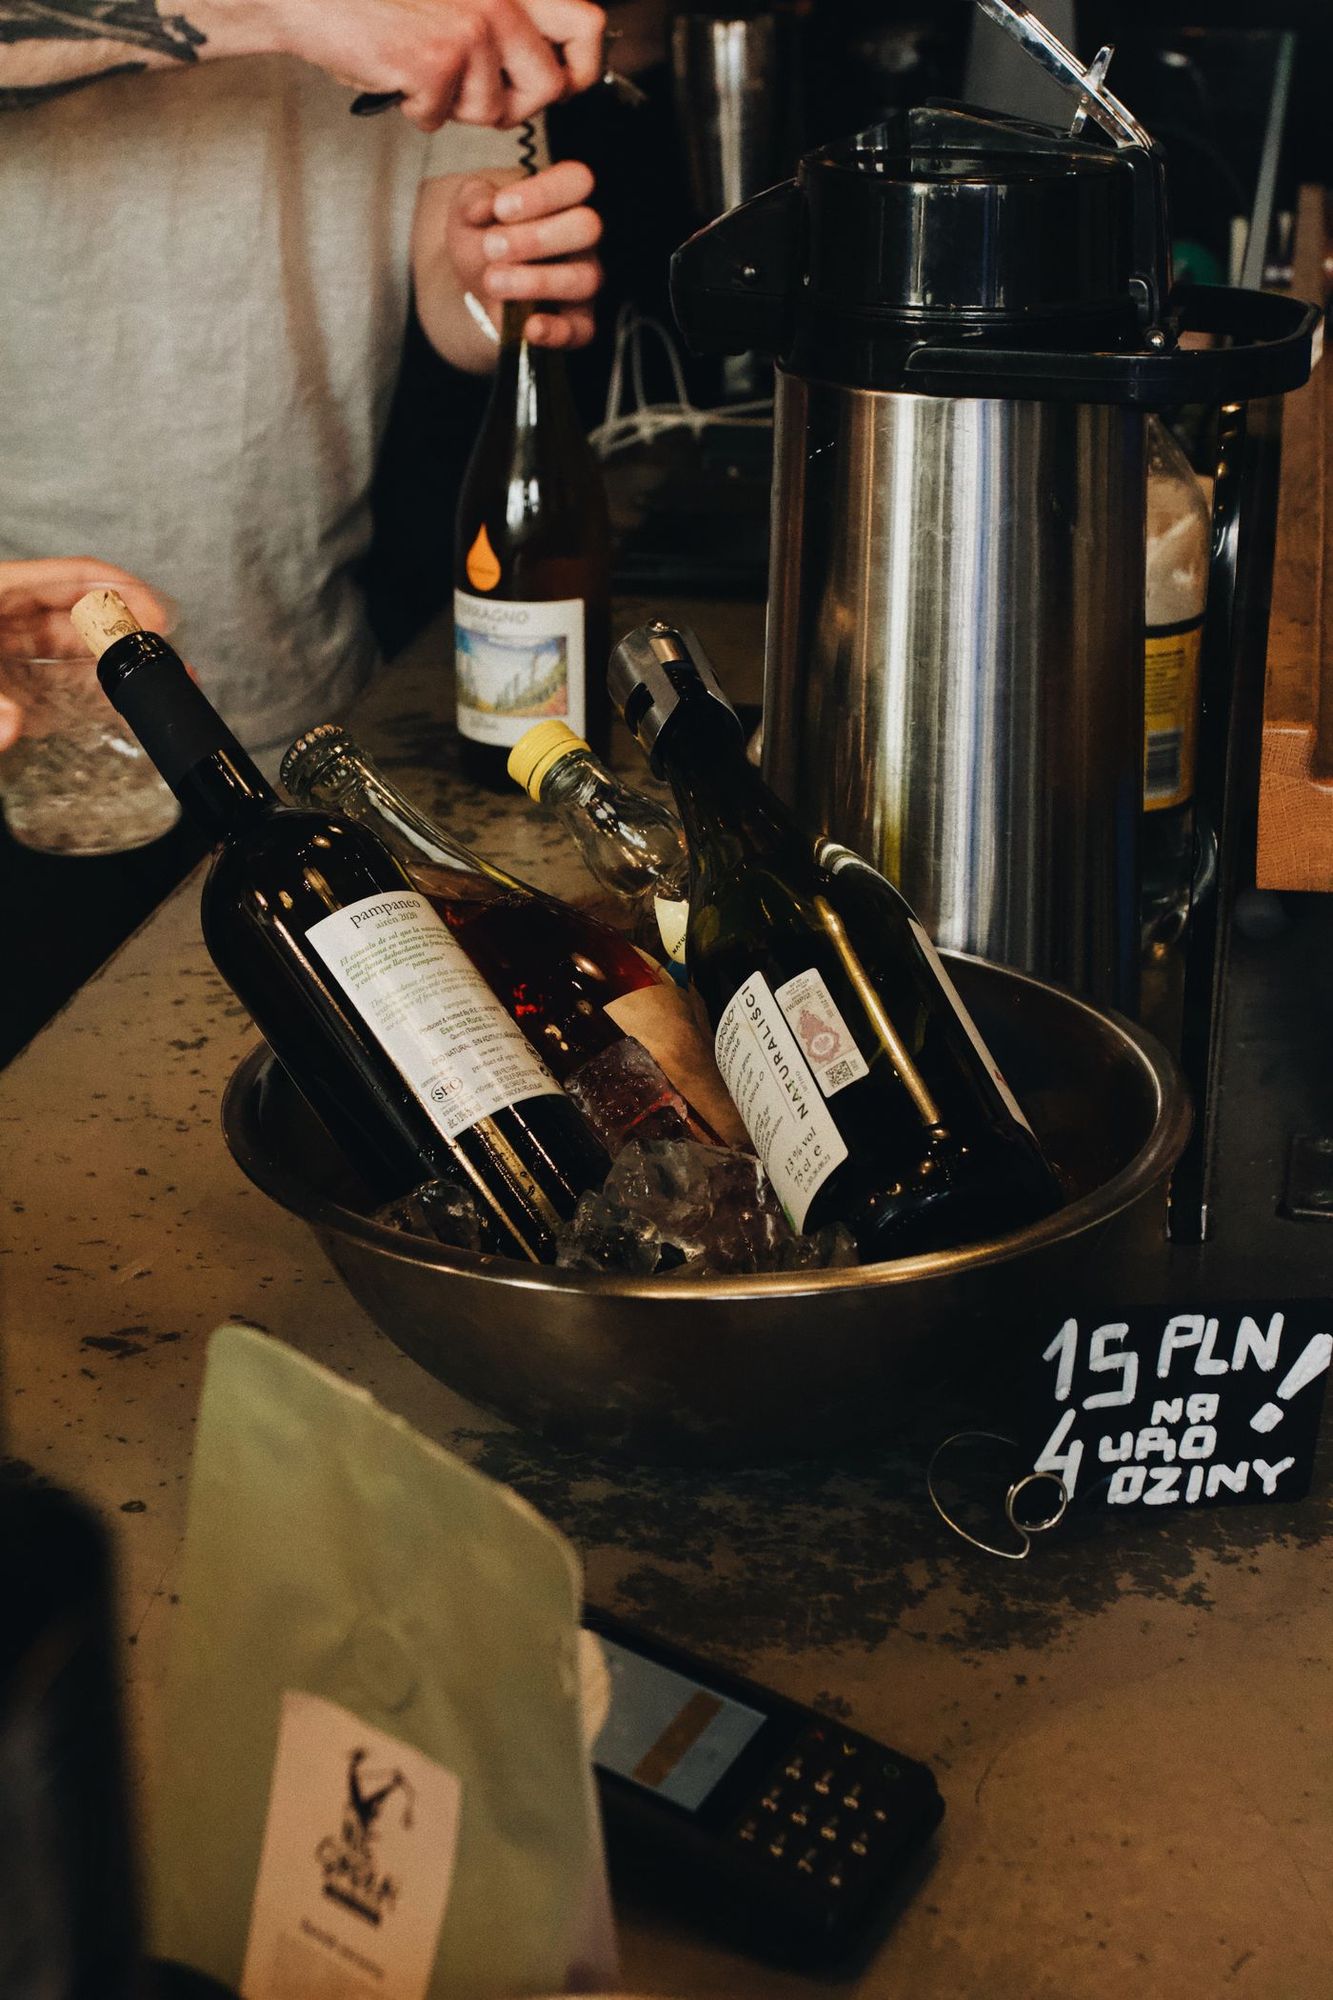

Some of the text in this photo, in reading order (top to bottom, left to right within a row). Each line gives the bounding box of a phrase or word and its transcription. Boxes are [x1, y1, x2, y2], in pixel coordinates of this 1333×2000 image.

[741, 985, 809, 1120] NATURALIŚCI
[802, 1126, 816, 1146] vol
[1042, 1318, 1139, 1411] 15
[1157, 1312, 1285, 1379] PLN
